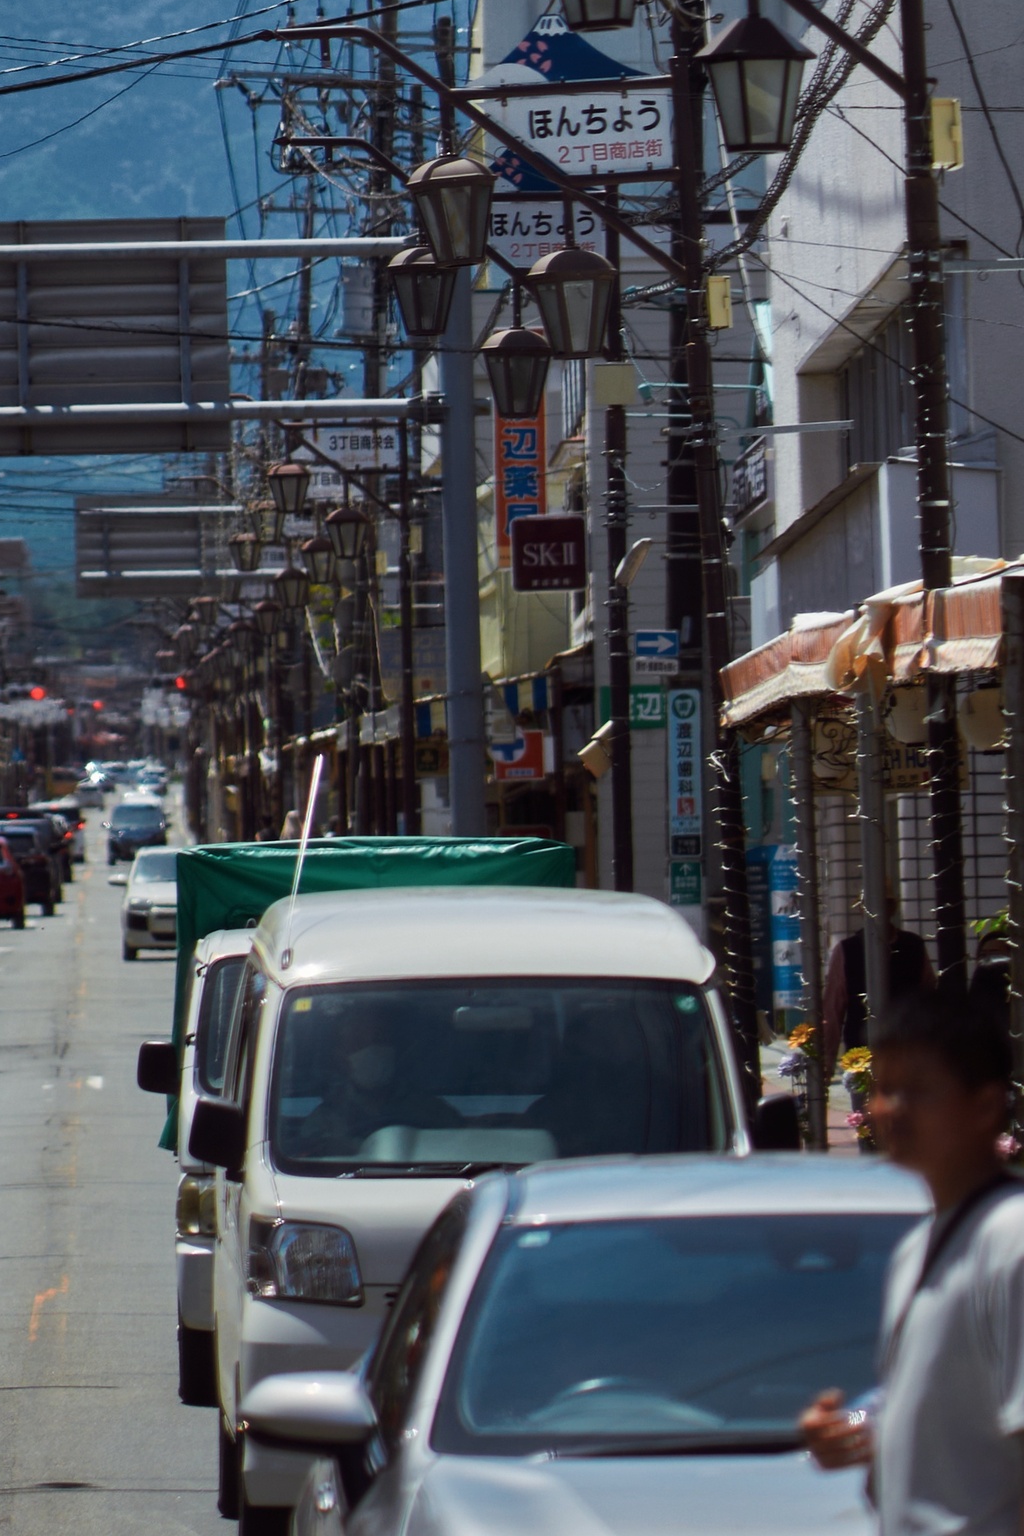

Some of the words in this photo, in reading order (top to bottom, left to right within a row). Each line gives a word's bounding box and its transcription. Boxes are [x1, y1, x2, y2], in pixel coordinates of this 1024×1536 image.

[529, 100, 660, 139] ほんちょう
[558, 139, 663, 164] 2丁目商店街
[329, 435, 394, 451] 3丁目商栄会
